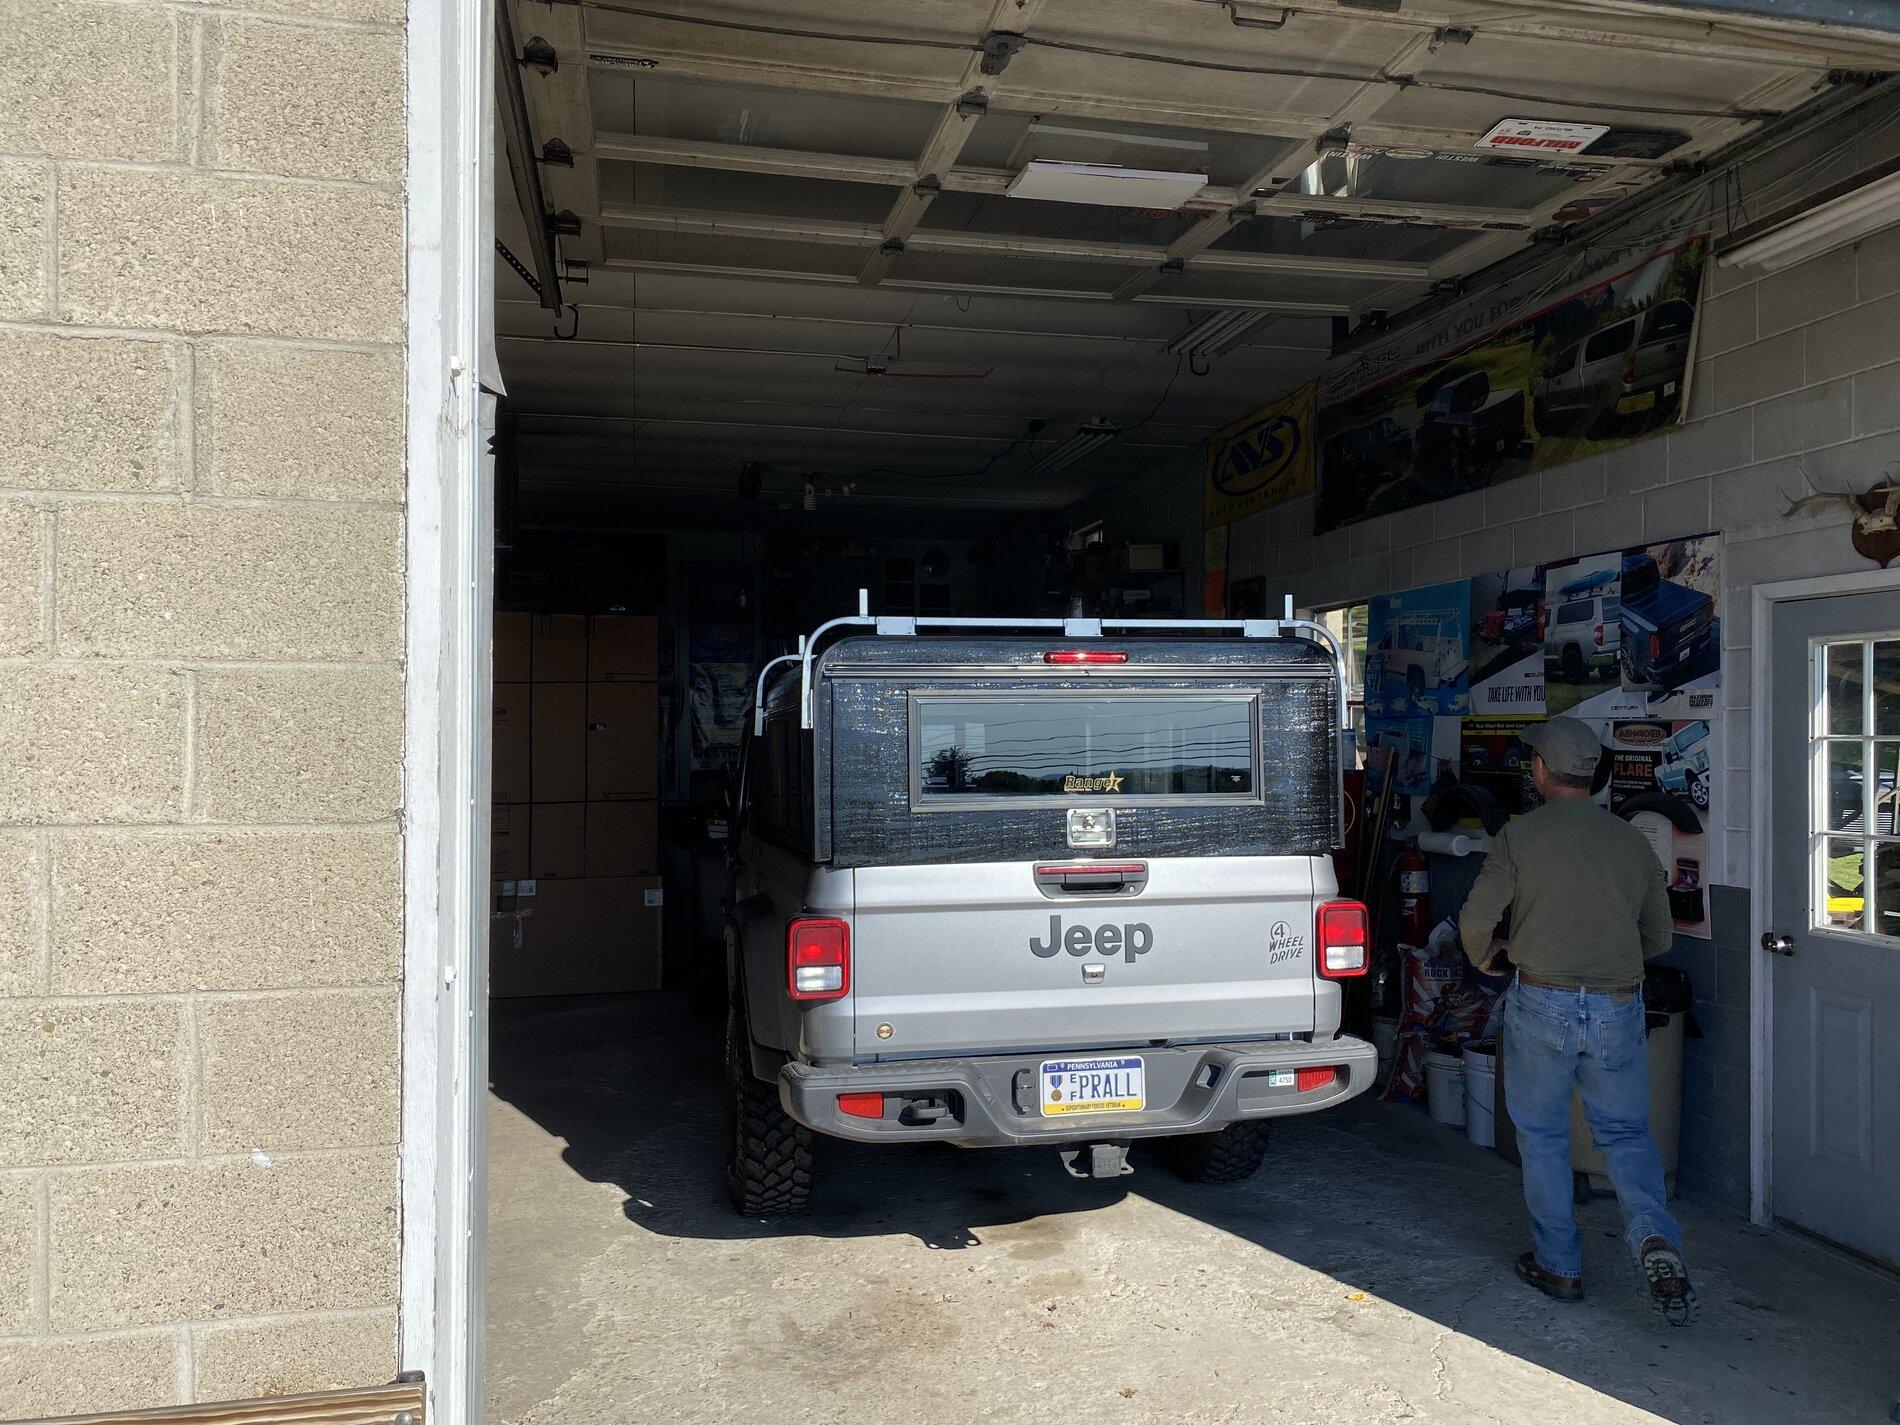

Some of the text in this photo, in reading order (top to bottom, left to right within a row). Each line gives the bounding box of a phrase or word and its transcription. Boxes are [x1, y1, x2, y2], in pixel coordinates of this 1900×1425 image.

[1490, 136, 1581, 148] MILFORD
[1454, 310, 1486, 339] YOU
[1220, 424, 1284, 482] AVS
[1487, 684, 1545, 702] TAKE LIFE WITH YOU
[1613, 763, 1652, 777] FLARE
[1029, 914, 1154, 963] Jeep
[1273, 923, 1285, 938] 4
[1269, 935, 1304, 953] WHEEL
[1270, 947, 1303, 964] DRIVE
[1424, 968, 1448, 978] ROCK
[1067, 1061, 1118, 1071] PENNSYLVANIA
[1070, 1072, 1138, 1100] E PRALL
[1070, 1090, 1077, 1101] F
